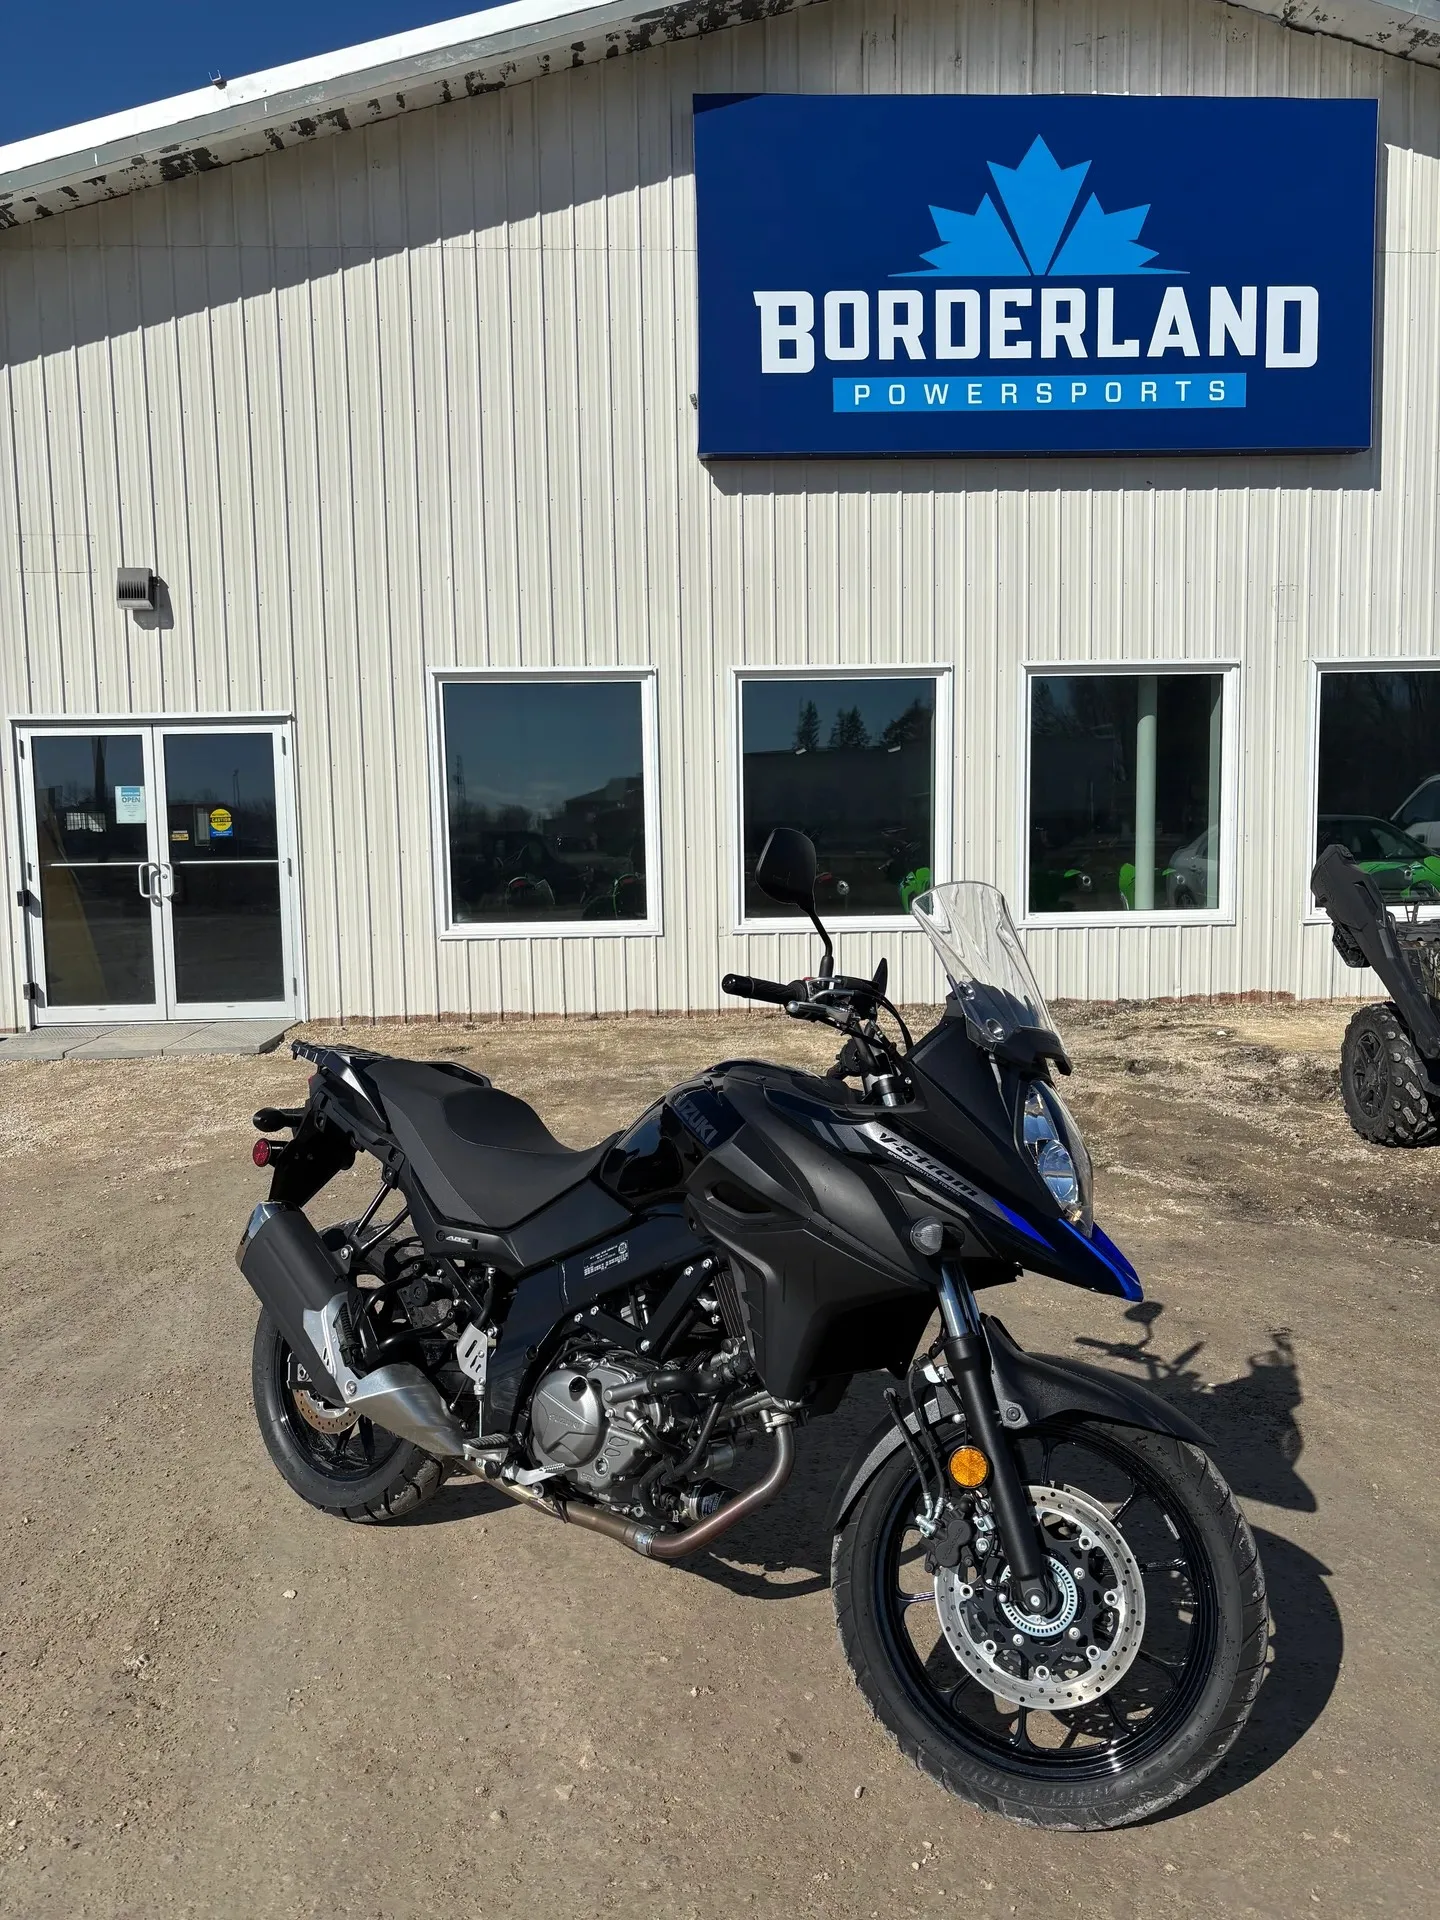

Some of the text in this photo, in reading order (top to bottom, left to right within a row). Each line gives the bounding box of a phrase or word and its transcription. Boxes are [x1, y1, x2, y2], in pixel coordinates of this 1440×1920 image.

[753, 285, 1319, 374] BORDERLAND
[854, 379, 1226, 406] POWERSPORTS
[674, 1097, 718, 1144] UZUKI
[887, 1151, 906, 1164] SPORT
[905, 1162, 938, 1183] ADVENTURE
[445, 1235, 471, 1244] ABS
